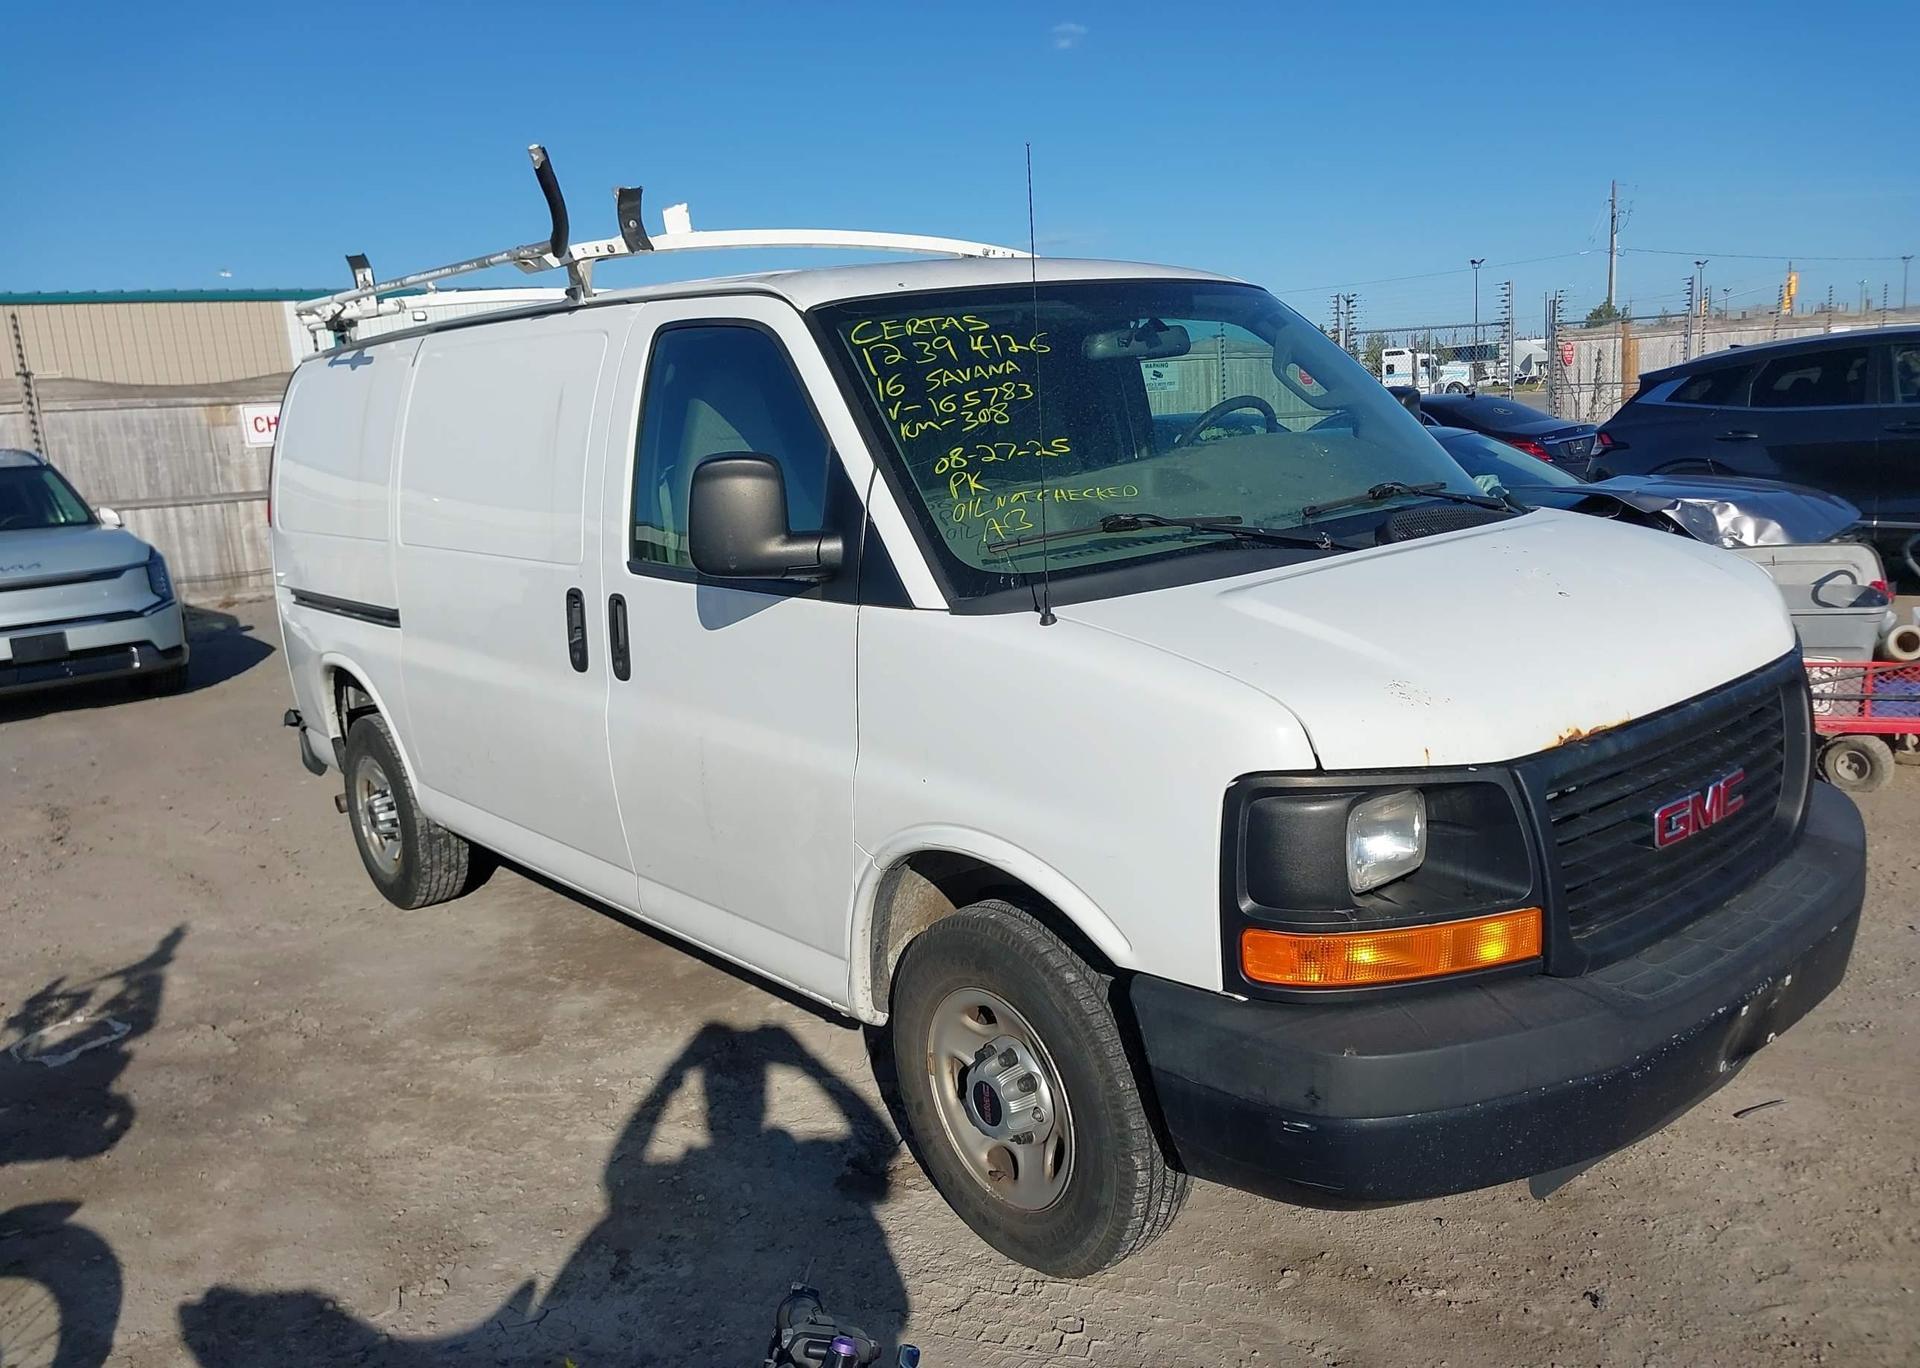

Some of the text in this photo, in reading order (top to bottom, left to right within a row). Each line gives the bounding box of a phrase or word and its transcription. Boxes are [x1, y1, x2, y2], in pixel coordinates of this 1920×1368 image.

[851, 315, 990, 345] CERTAS
[877, 359, 1021, 402] 16 SAVANA
[934, 438, 1071, 475] 08-27-25
[949, 470, 992, 500] PK
[952, 497, 994, 522] OIL
[1036, 485, 1138, 503] CHECKED
[1654, 767, 1745, 849] GMC
